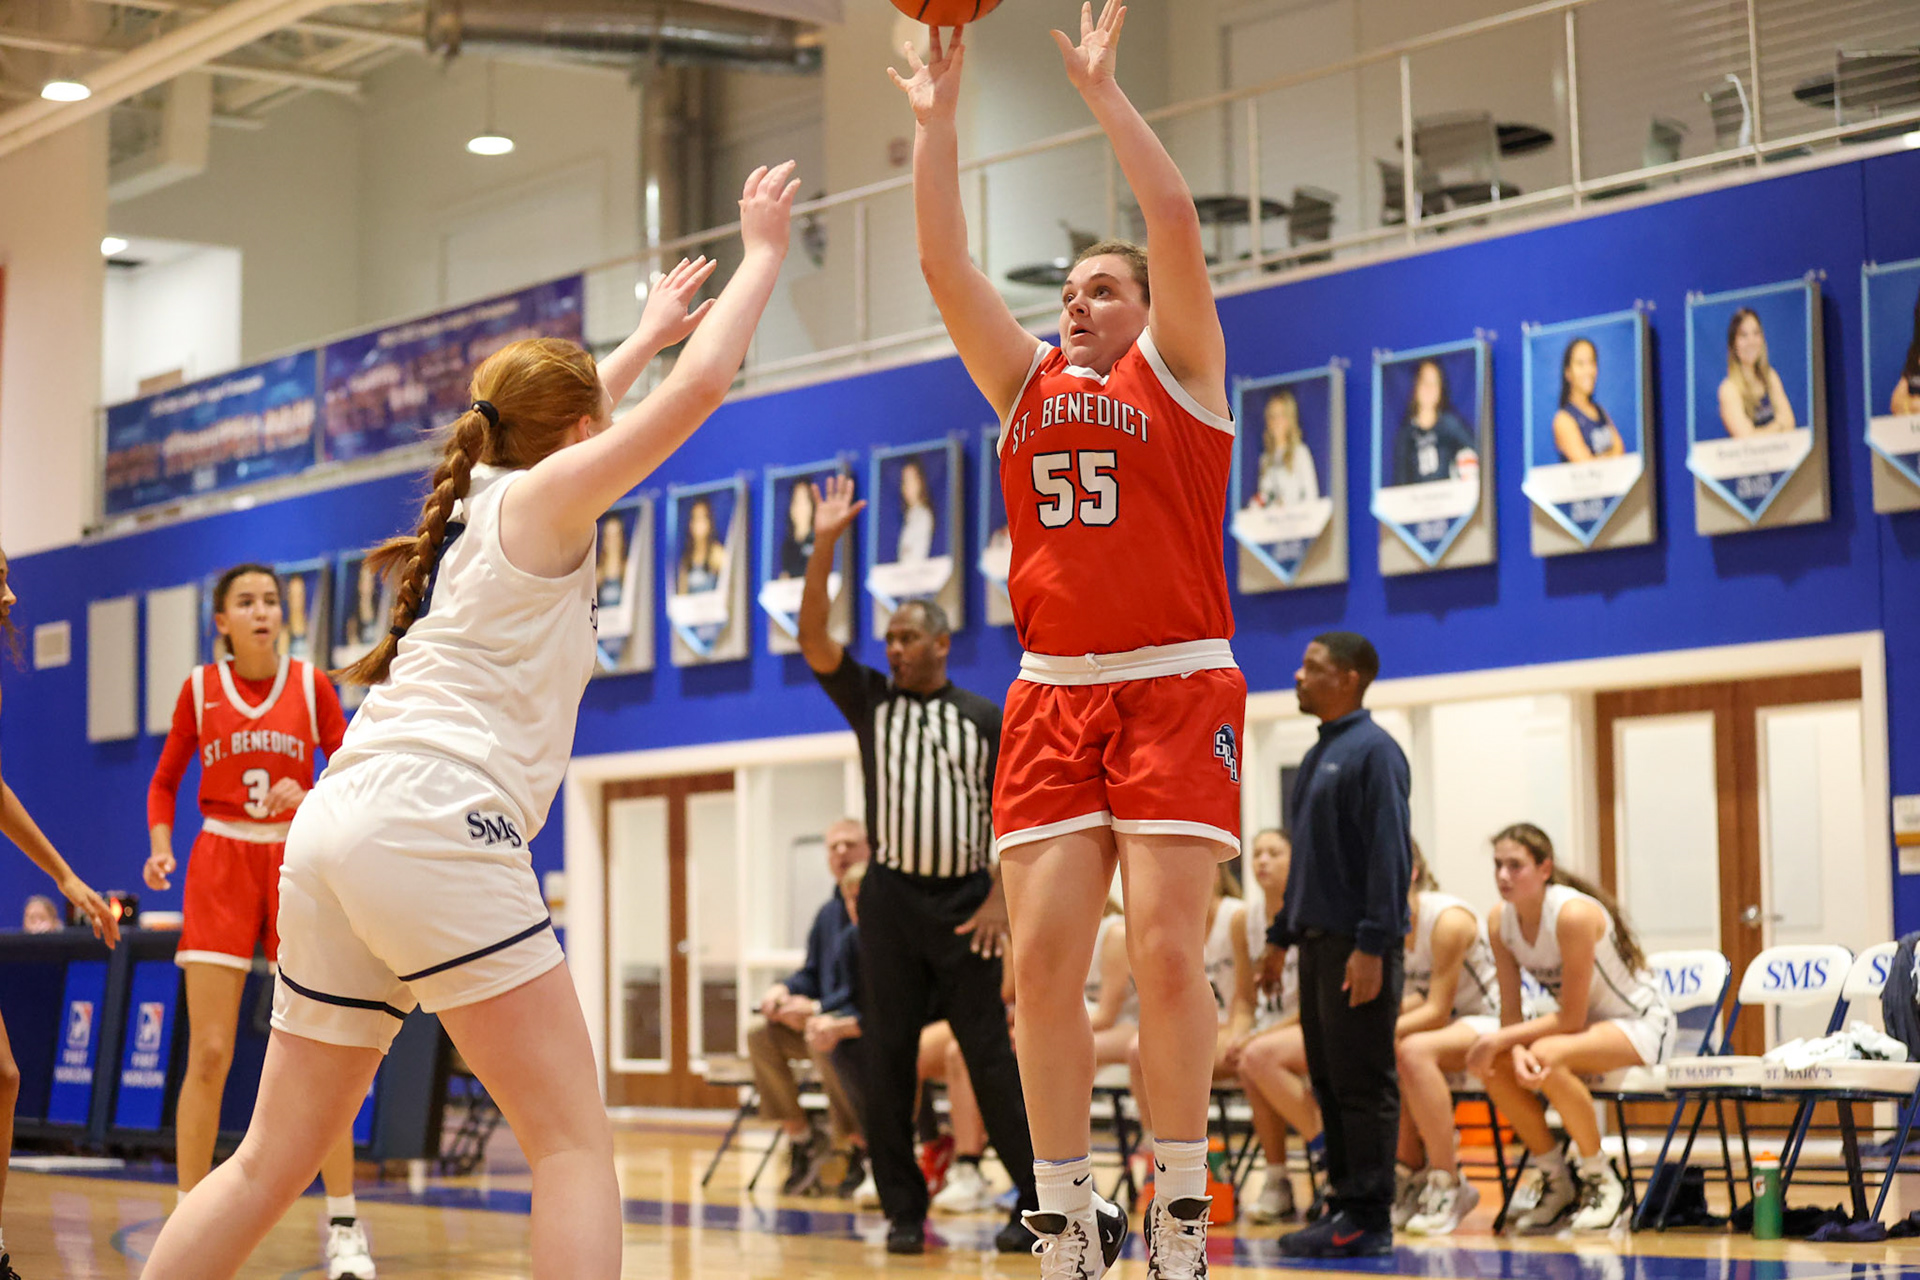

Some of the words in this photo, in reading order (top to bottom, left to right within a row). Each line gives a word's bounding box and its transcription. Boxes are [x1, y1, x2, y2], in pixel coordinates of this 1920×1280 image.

[1012, 410, 1036, 456] ST.
[1040, 392, 1150, 443] BENEDICT
[1031, 449, 1119, 529] 55
[204, 738, 228, 767] ST.
[230, 729, 305, 762] BENEDICT
[242, 768, 271, 820] 3
[466, 811, 522, 848] SMS
[1763, 958, 1829, 990] SMS
